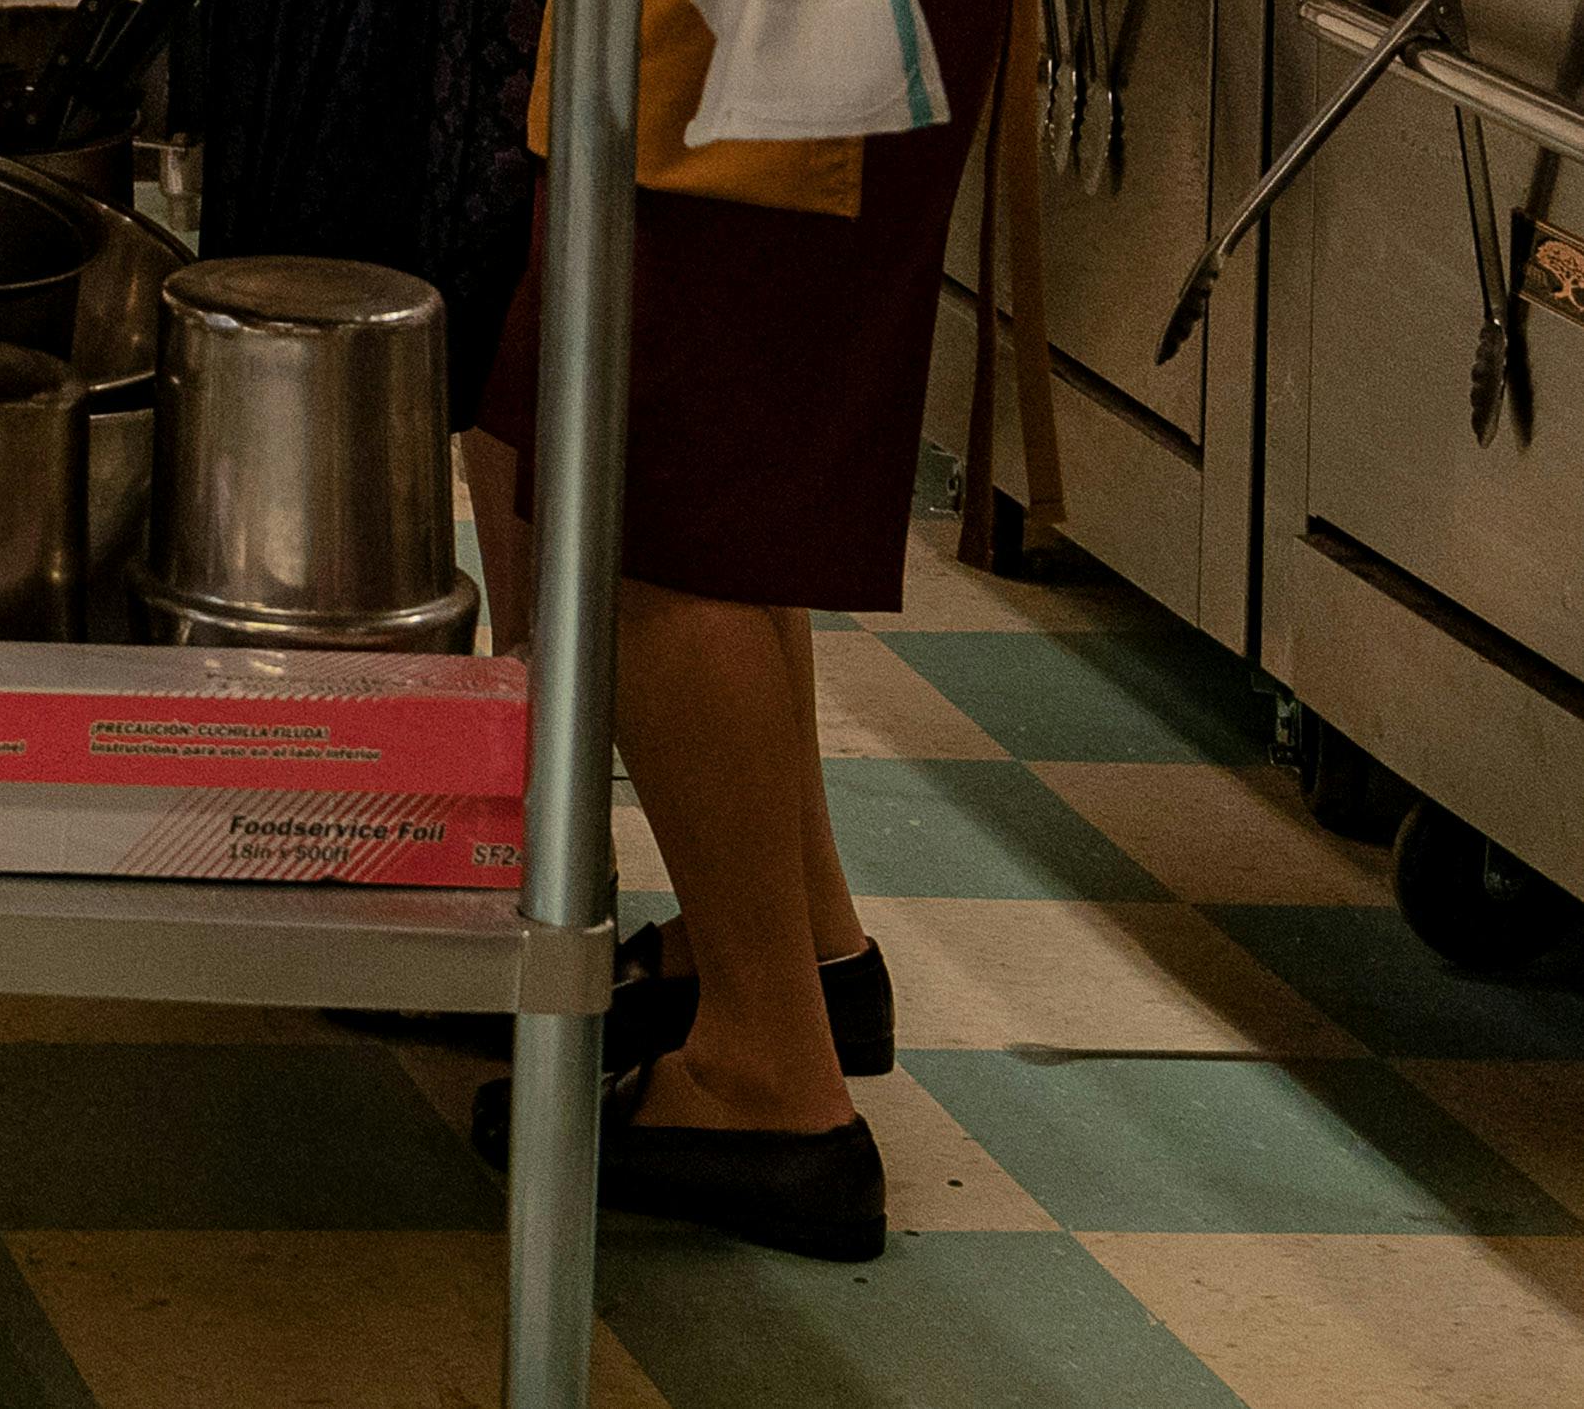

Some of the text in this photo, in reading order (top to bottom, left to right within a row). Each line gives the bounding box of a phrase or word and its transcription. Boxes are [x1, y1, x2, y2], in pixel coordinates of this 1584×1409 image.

[181, 744, 217, 758] para
[220, 745, 245, 757] uso
[289, 746, 322, 759] lado
[229, 815, 446, 843] Foodservice Foil
[229, 843, 271, 861] 18in
[296, 844, 351, 863] 500ft
